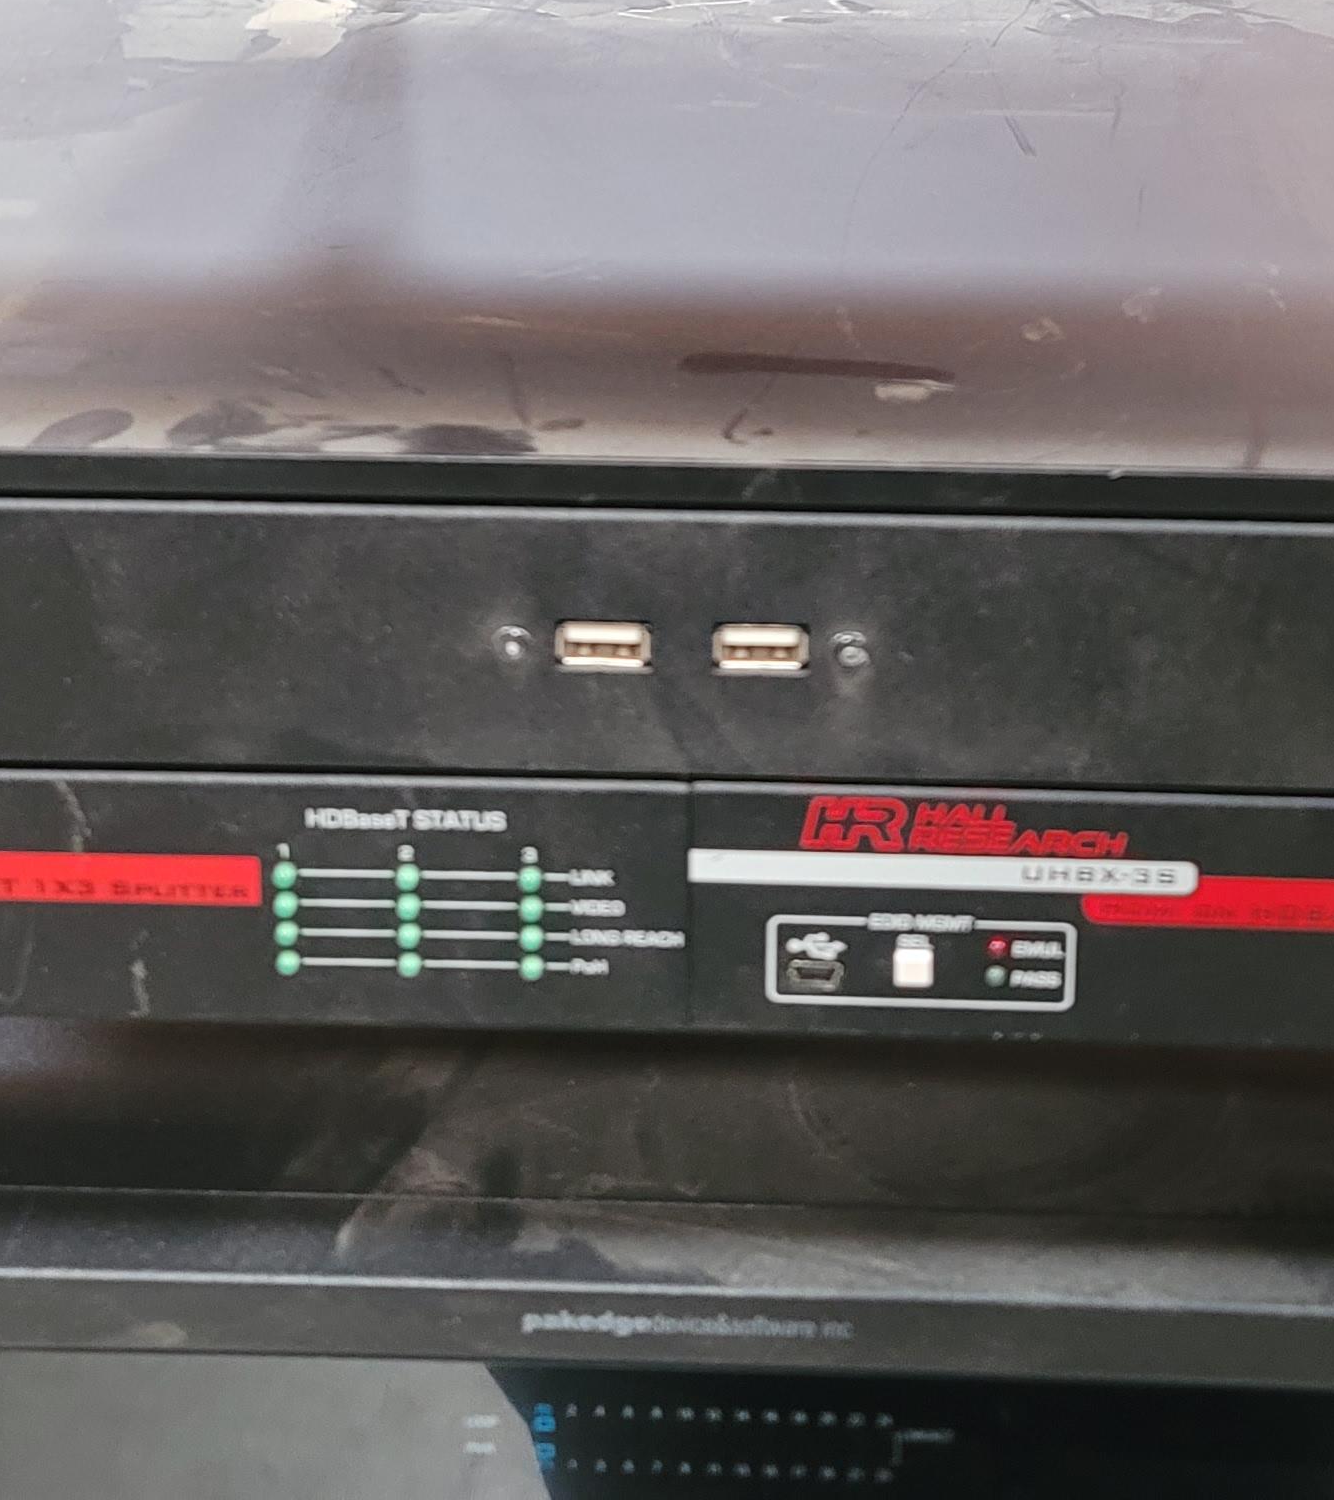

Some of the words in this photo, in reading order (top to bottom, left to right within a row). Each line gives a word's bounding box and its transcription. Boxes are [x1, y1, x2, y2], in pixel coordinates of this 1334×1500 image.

[304, 808, 410, 830] HDBaseT
[411, 809, 508, 832] STATUS
[913, 803, 1010, 826] HALL
[908, 823, 1129, 856] RESEARCH
[276, 843, 290, 860] 1
[1020, 866, 1178, 885] UHBX-3S
